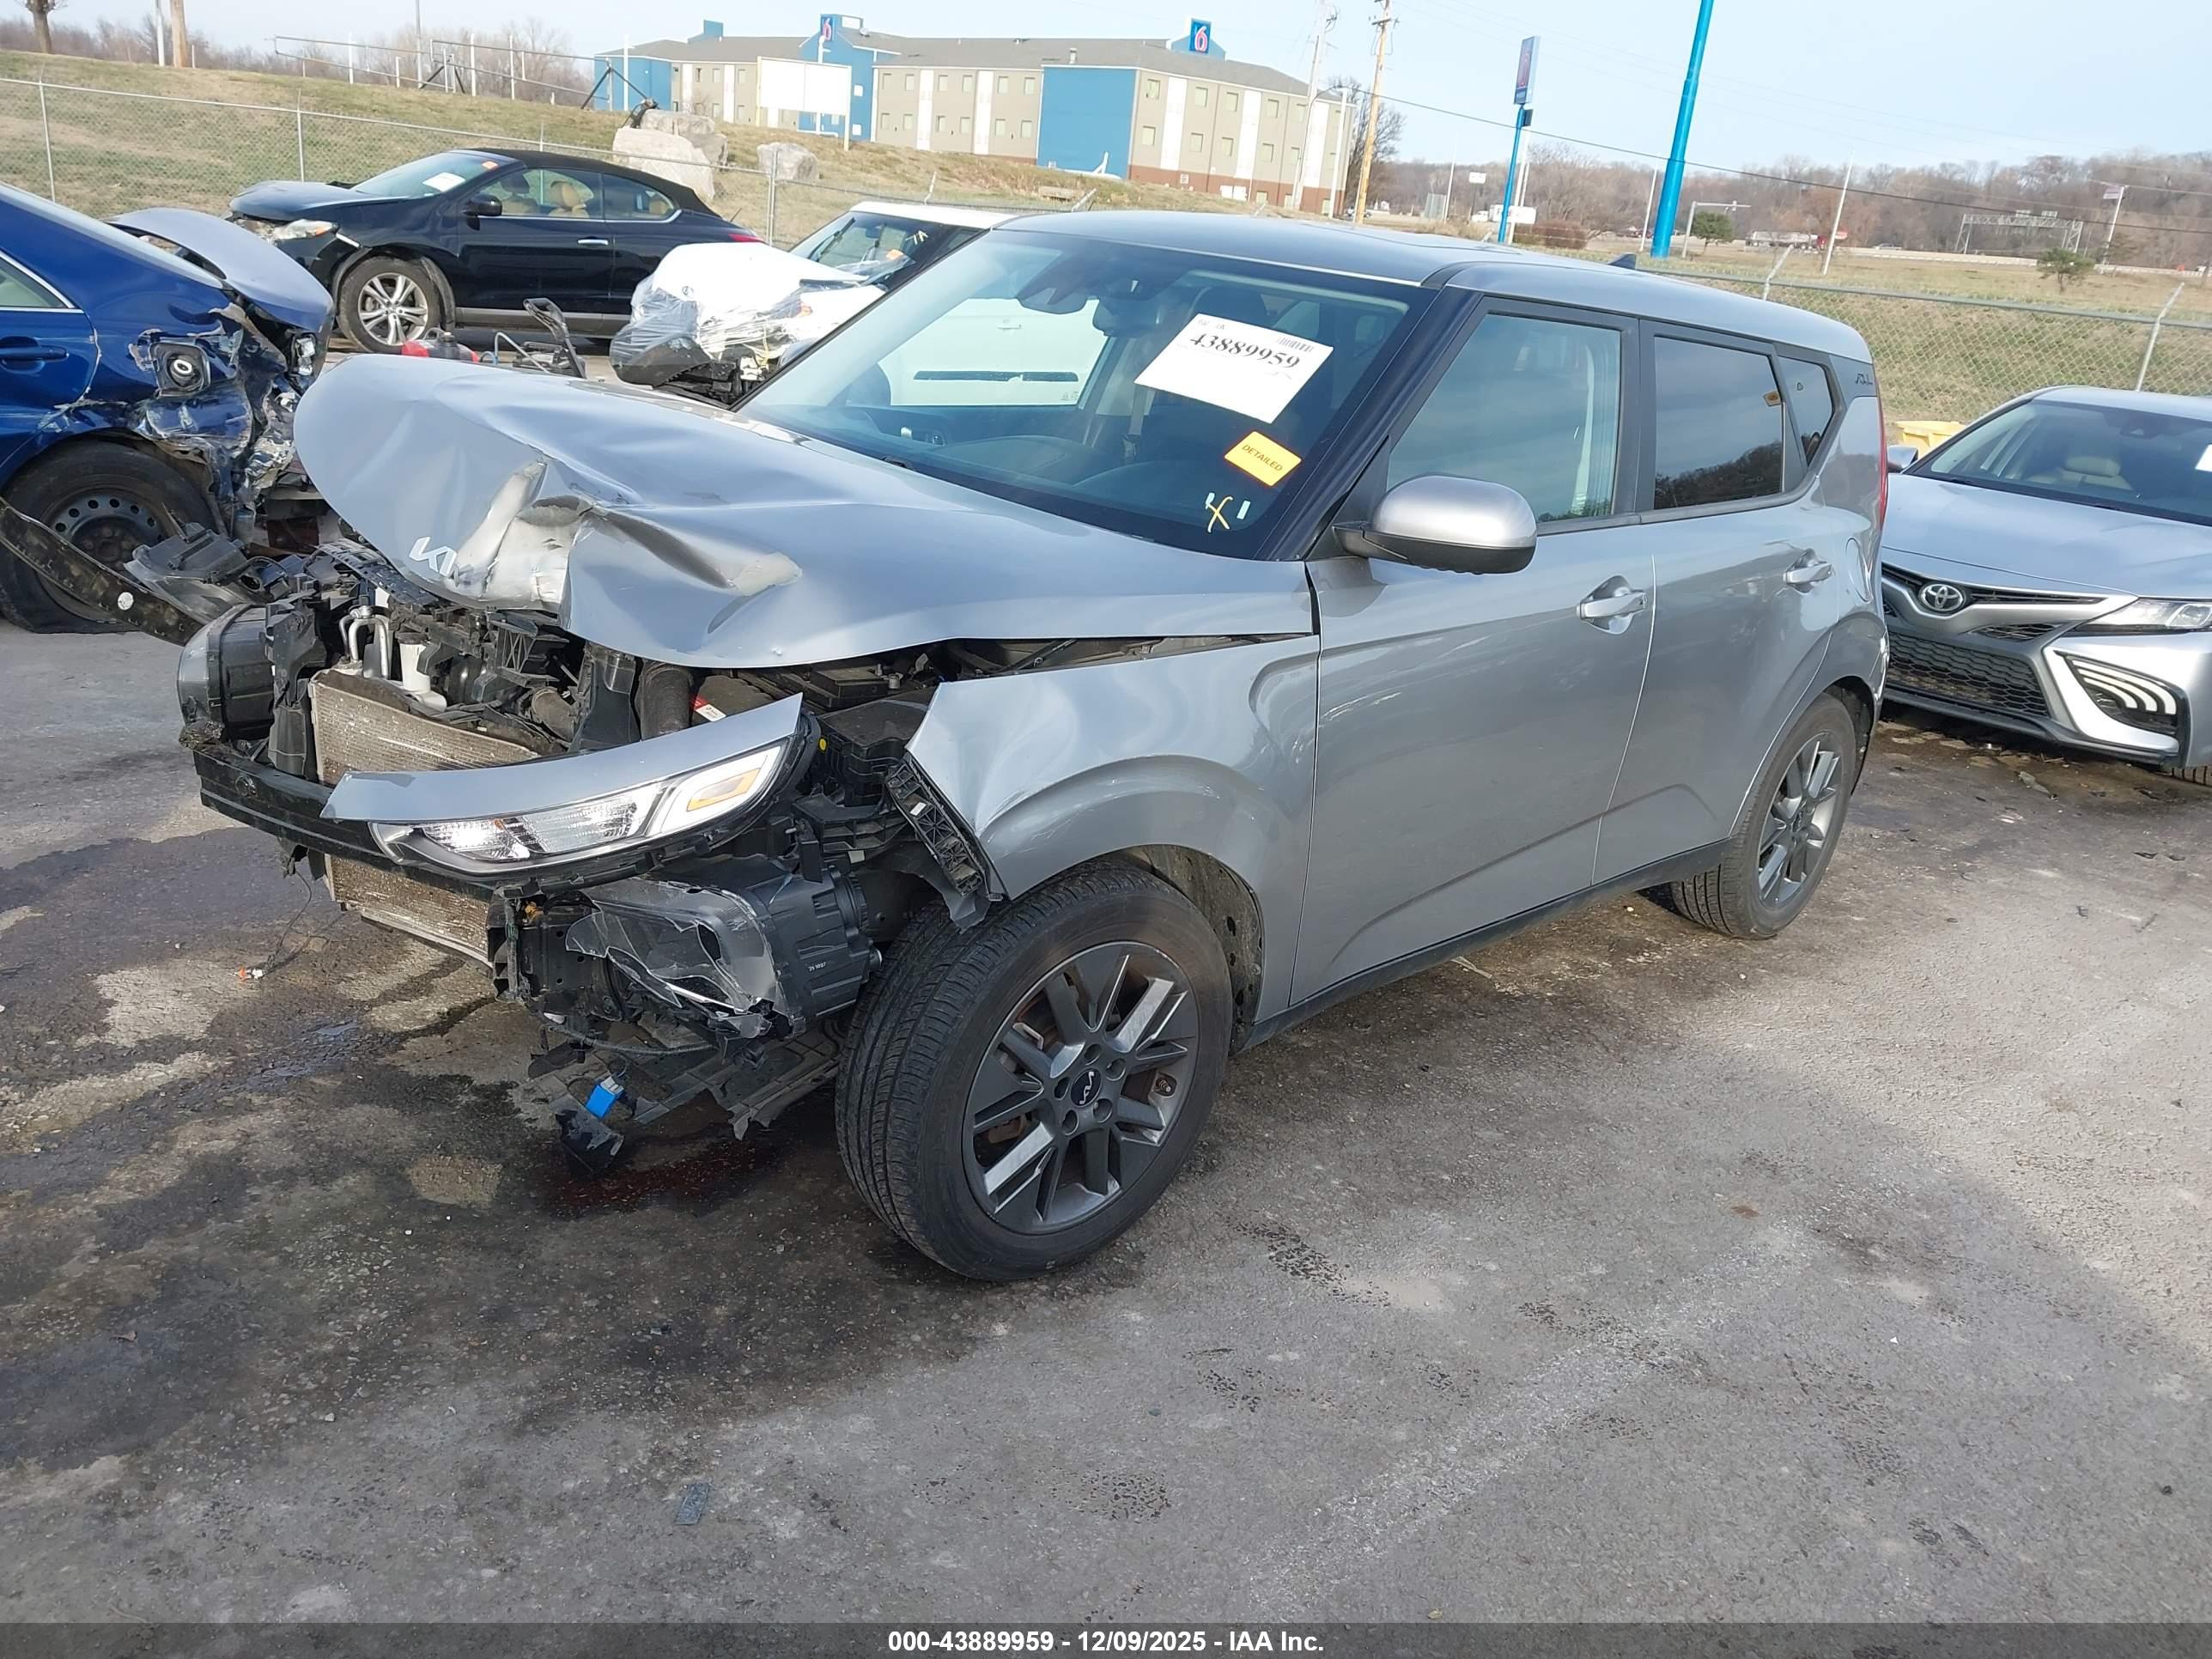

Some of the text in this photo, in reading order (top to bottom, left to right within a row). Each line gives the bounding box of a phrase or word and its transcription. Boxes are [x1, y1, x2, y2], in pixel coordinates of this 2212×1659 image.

[1194, 26, 1208, 52] 6
[1189, 333, 1301, 368] 43889959
[1242, 444, 1284, 471] DETAILED
